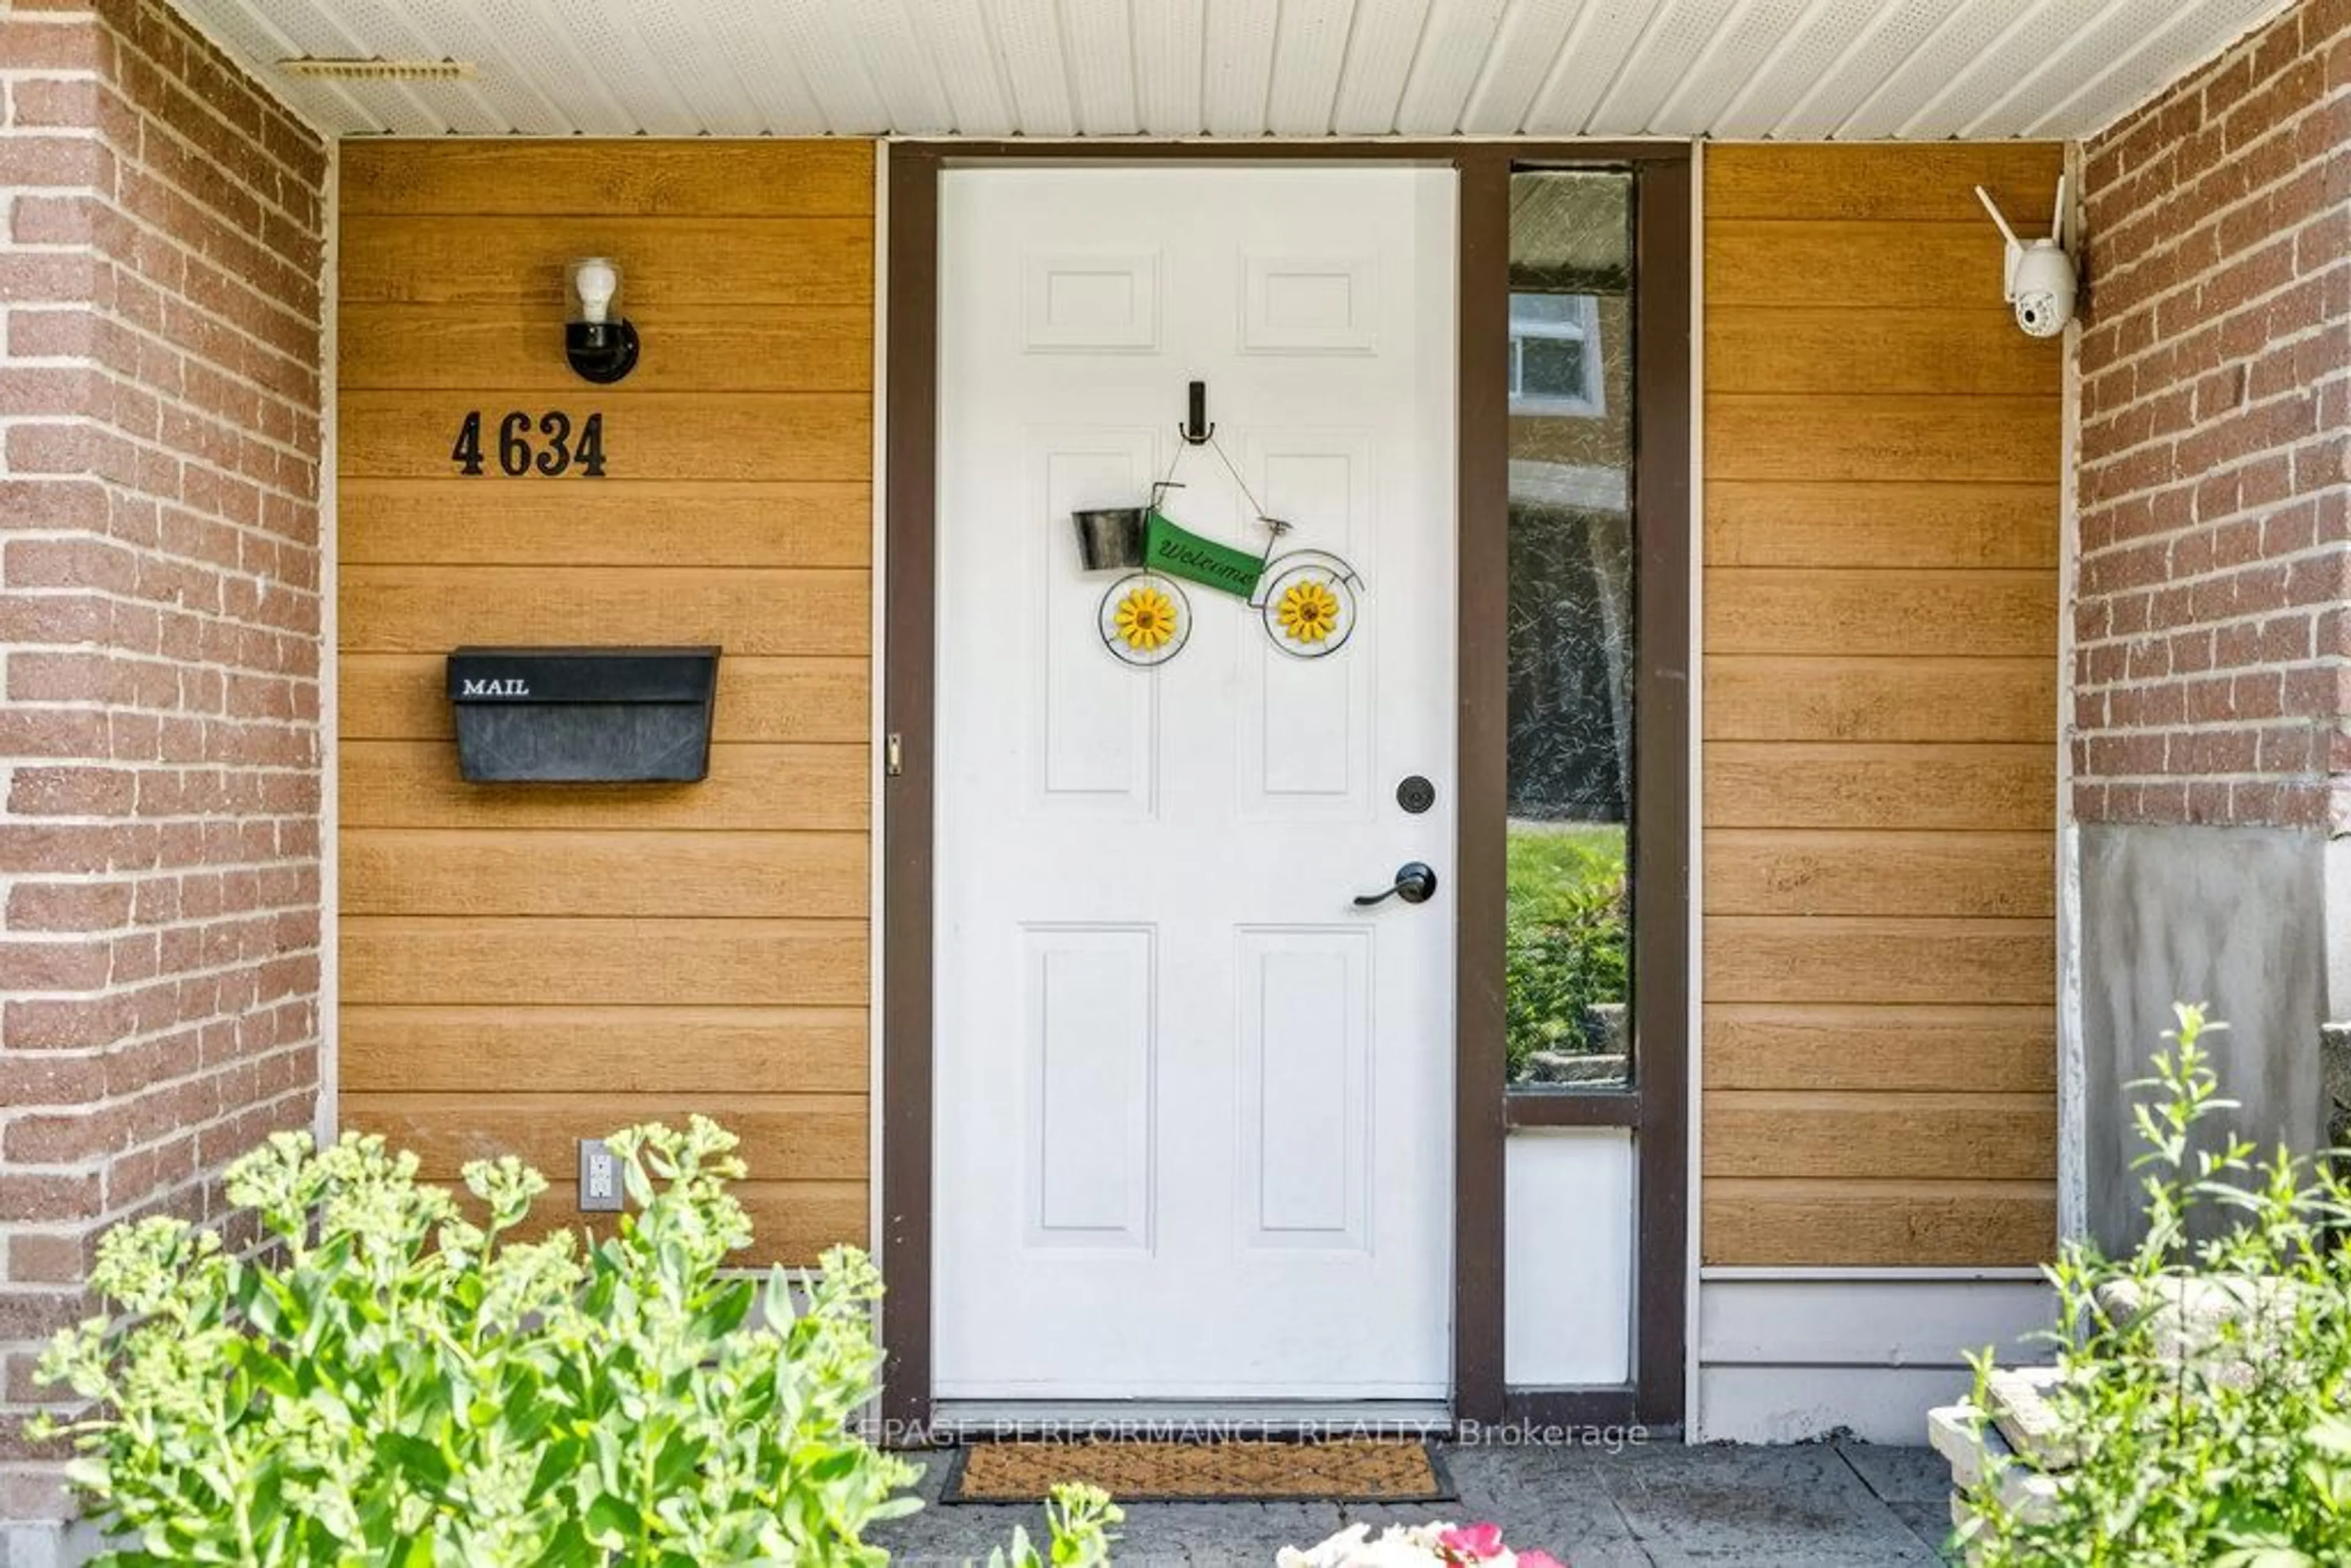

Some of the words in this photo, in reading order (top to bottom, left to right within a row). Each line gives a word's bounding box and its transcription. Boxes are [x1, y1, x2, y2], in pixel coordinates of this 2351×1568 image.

[451, 411, 606, 476] 4634
[1159, 539, 1255, 584] Welcome
[463, 678, 530, 694] MAIL
